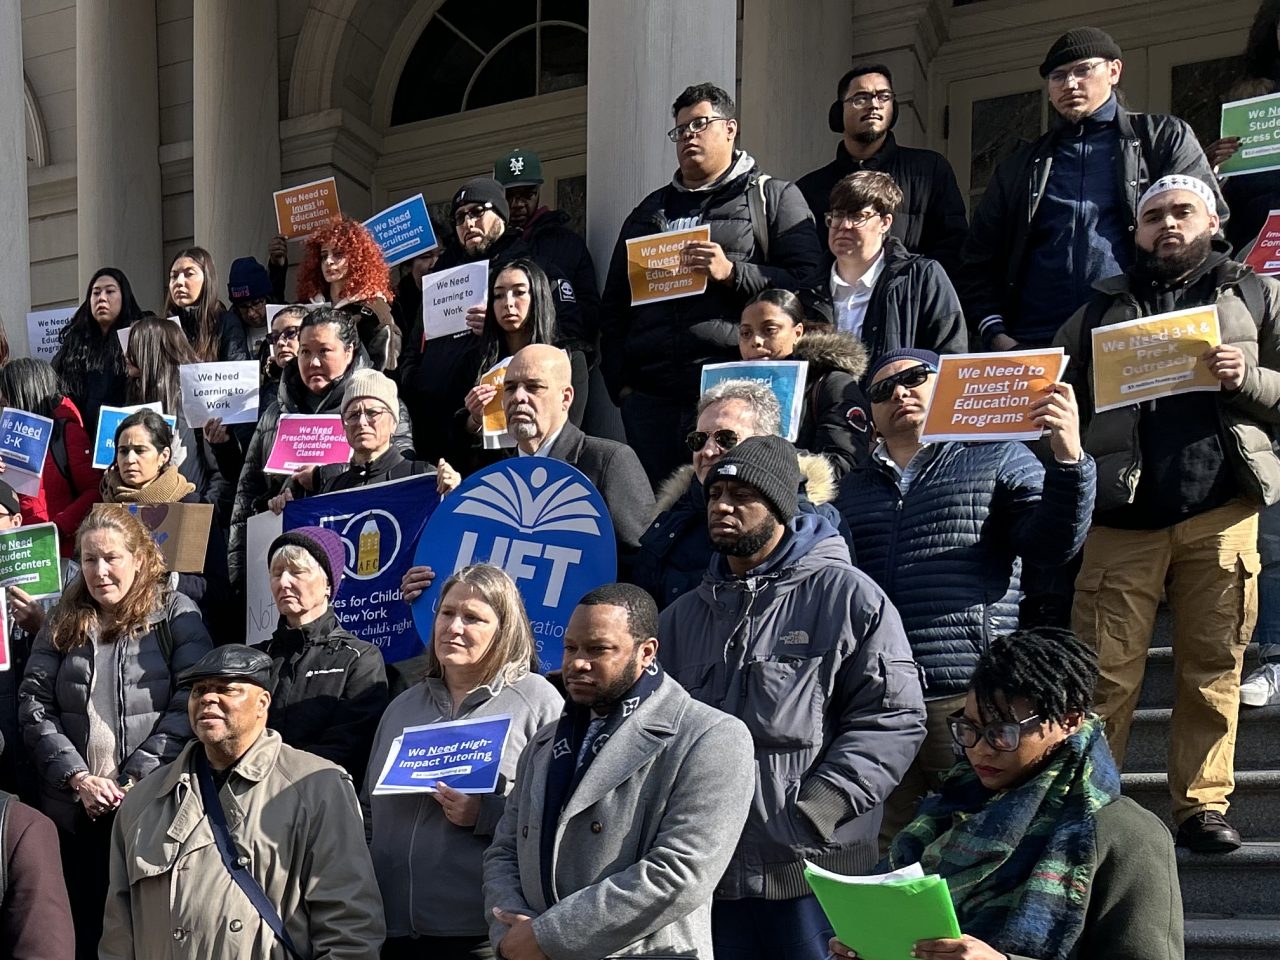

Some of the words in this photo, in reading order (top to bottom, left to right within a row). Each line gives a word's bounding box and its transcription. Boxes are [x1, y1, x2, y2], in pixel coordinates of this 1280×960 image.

[1248, 109, 1266, 120] We
[1240, 132, 1271, 144] ccess
[510, 157, 524, 176] NY
[285, 196, 298, 205] We
[298, 190, 319, 202] Need
[320, 188, 329, 196] to
[292, 202, 316, 214] Invest
[316, 198, 325, 208] in
[290, 208, 330, 223] Education
[374, 220, 387, 232] We
[388, 210, 412, 226] Need
[292, 217, 330, 232] Programs
[378, 220, 412, 241] Teacher
[640, 246, 656, 257] We
[658, 240, 685, 254] Need
[648, 254, 680, 268] Invest
[436, 280, 449, 290] We
[450, 274, 470, 286] Need
[648, 278, 693, 292] Programs
[433, 292, 464, 306] Learning
[464, 290, 474, 298] to
[442, 306, 464, 318] Work
[50, 317, 70, 326] Need
[1102, 340, 1126, 352] We
[1129, 328, 1169, 350] Need
[1172, 324, 1198, 339] 3-K
[1136, 343, 1180, 360] Pre-K
[198, 373, 213, 382] We
[214, 372, 240, 382] Need
[958, 366, 981, 380] We
[983, 364, 1025, 378] Need
[1028, 366, 1046, 376] to
[194, 387, 233, 397] Learning
[962, 380, 1010, 396] Invest
[1013, 378, 1028, 391] in
[206, 400, 231, 409] Work
[954, 395, 1030, 410] Education
[951, 412, 1024, 428] Programs
[2, 418, 14, 429] We
[13, 420, 42, 440] Need
[299, 426, 312, 434] We
[311, 425, 334, 435] Need
[4, 434, 22, 448] 3-K
[280, 434, 318, 442] Preschool
[292, 442, 332, 450] Education
[296, 450, 325, 458] Classes
[8, 536, 33, 551] Need
[14, 558, 52, 571] Centers
[350, 594, 367, 607] for
[370, 588, 404, 604] Childr
[361, 607, 388, 620] York
[362, 622, 390, 636] child's
[392, 618, 413, 634] right
[408, 748, 426, 757] We
[426, 742, 458, 756] Need
[460, 738, 493, 750] High-
[399, 758, 440, 770] Impact
[442, 750, 493, 764] Tutoring
